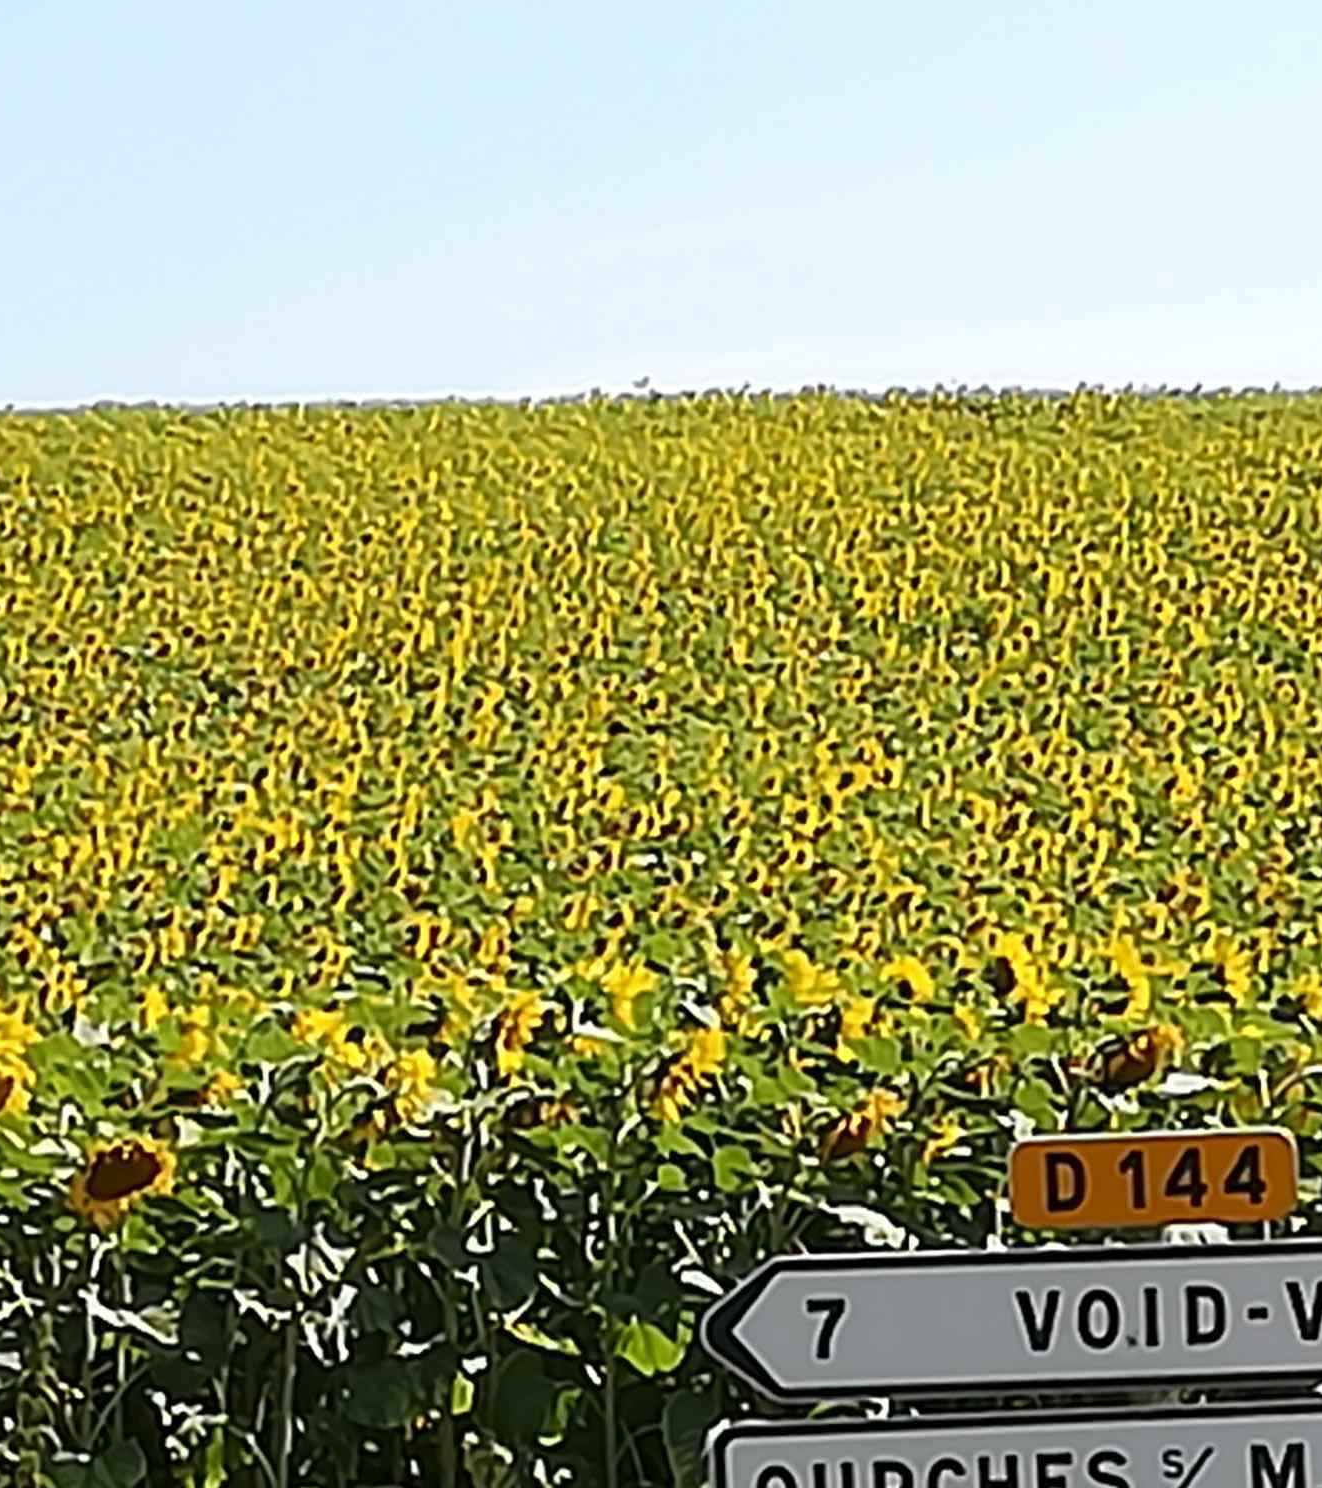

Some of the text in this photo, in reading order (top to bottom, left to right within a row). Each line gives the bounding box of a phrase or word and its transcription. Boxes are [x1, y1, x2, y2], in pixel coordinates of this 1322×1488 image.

[1044, 1144, 1267, 1213] D 144
[805, 1298, 846, 1360] 7
